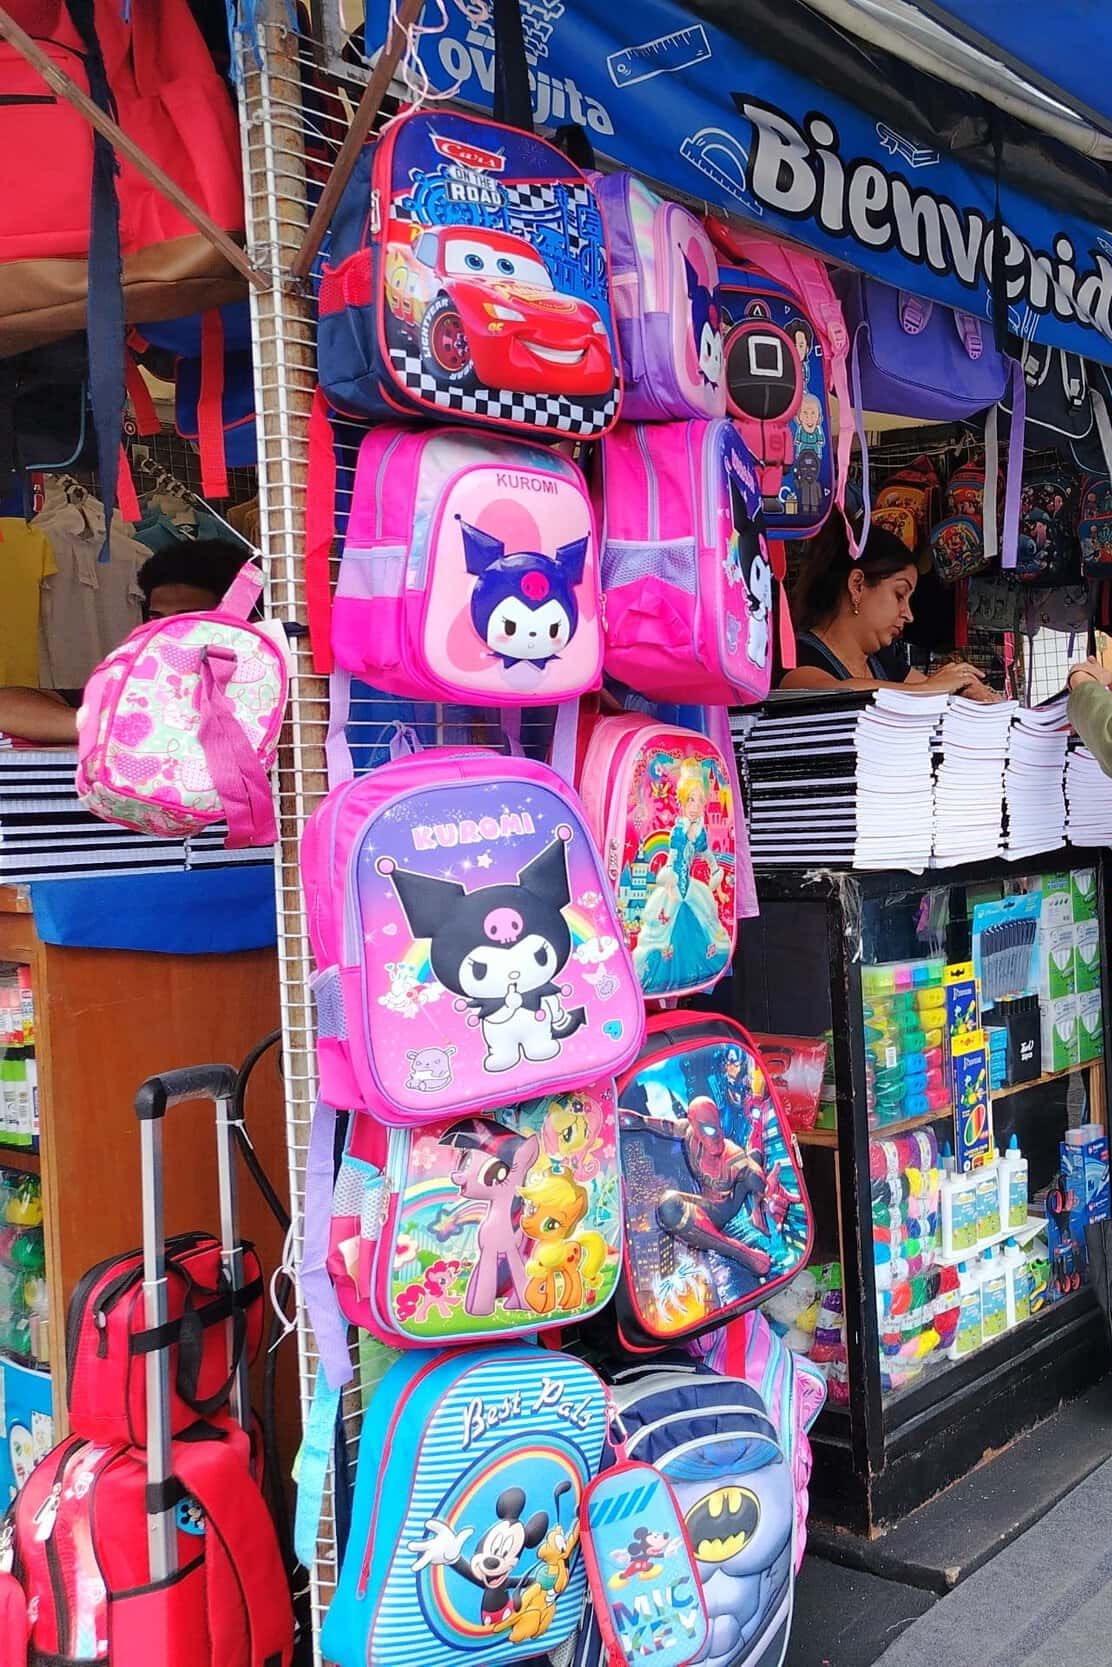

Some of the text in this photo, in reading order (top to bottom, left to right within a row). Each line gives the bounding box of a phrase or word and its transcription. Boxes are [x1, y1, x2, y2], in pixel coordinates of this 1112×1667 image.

[441, 141, 498, 169] Cars
[454, 167, 494, 190] ON THE
[452, 181, 502, 206] ROAD
[420, 298, 450, 360] LIGHTYEAR
[496, 473, 558, 495] KUROMI
[411, 812, 536, 850] KUROMI
[462, 1376, 593, 1451] Best Pals
